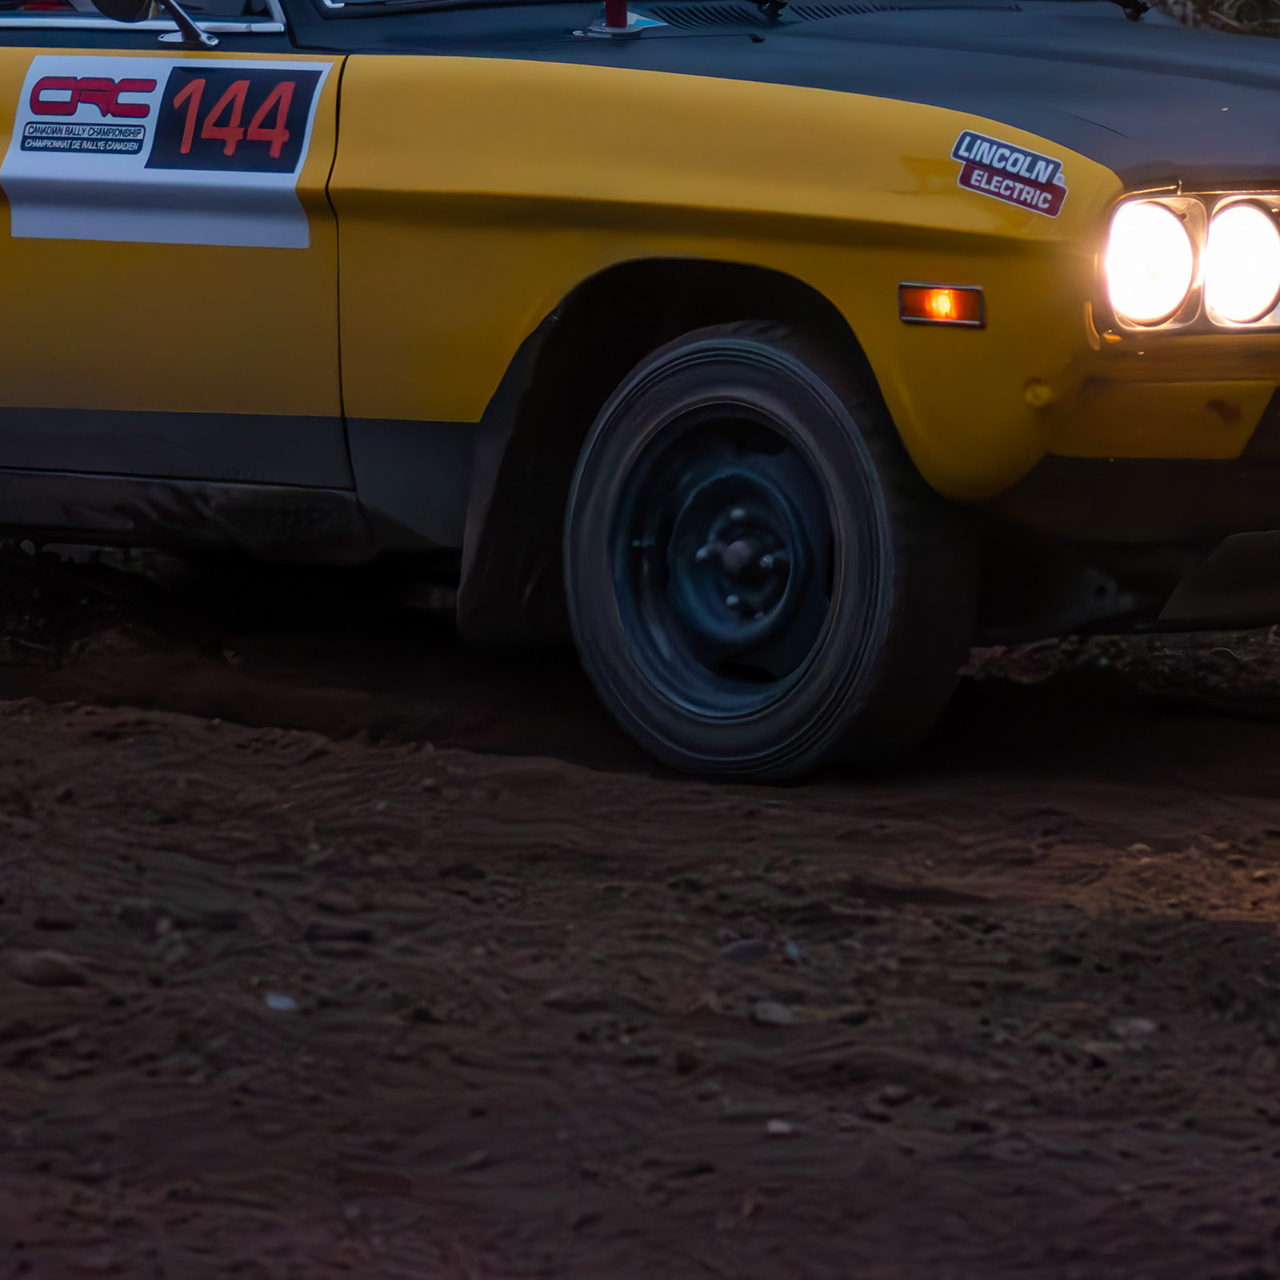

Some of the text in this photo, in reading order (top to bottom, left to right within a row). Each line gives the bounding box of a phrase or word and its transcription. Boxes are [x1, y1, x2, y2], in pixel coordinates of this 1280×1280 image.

[64, 126, 86, 136] RALLY
[173, 78, 296, 159] 144
[72, 140, 81, 149] DE
[958, 135, 1054, 184] LINCOLN
[970, 169, 1052, 209] ELECTRIC
